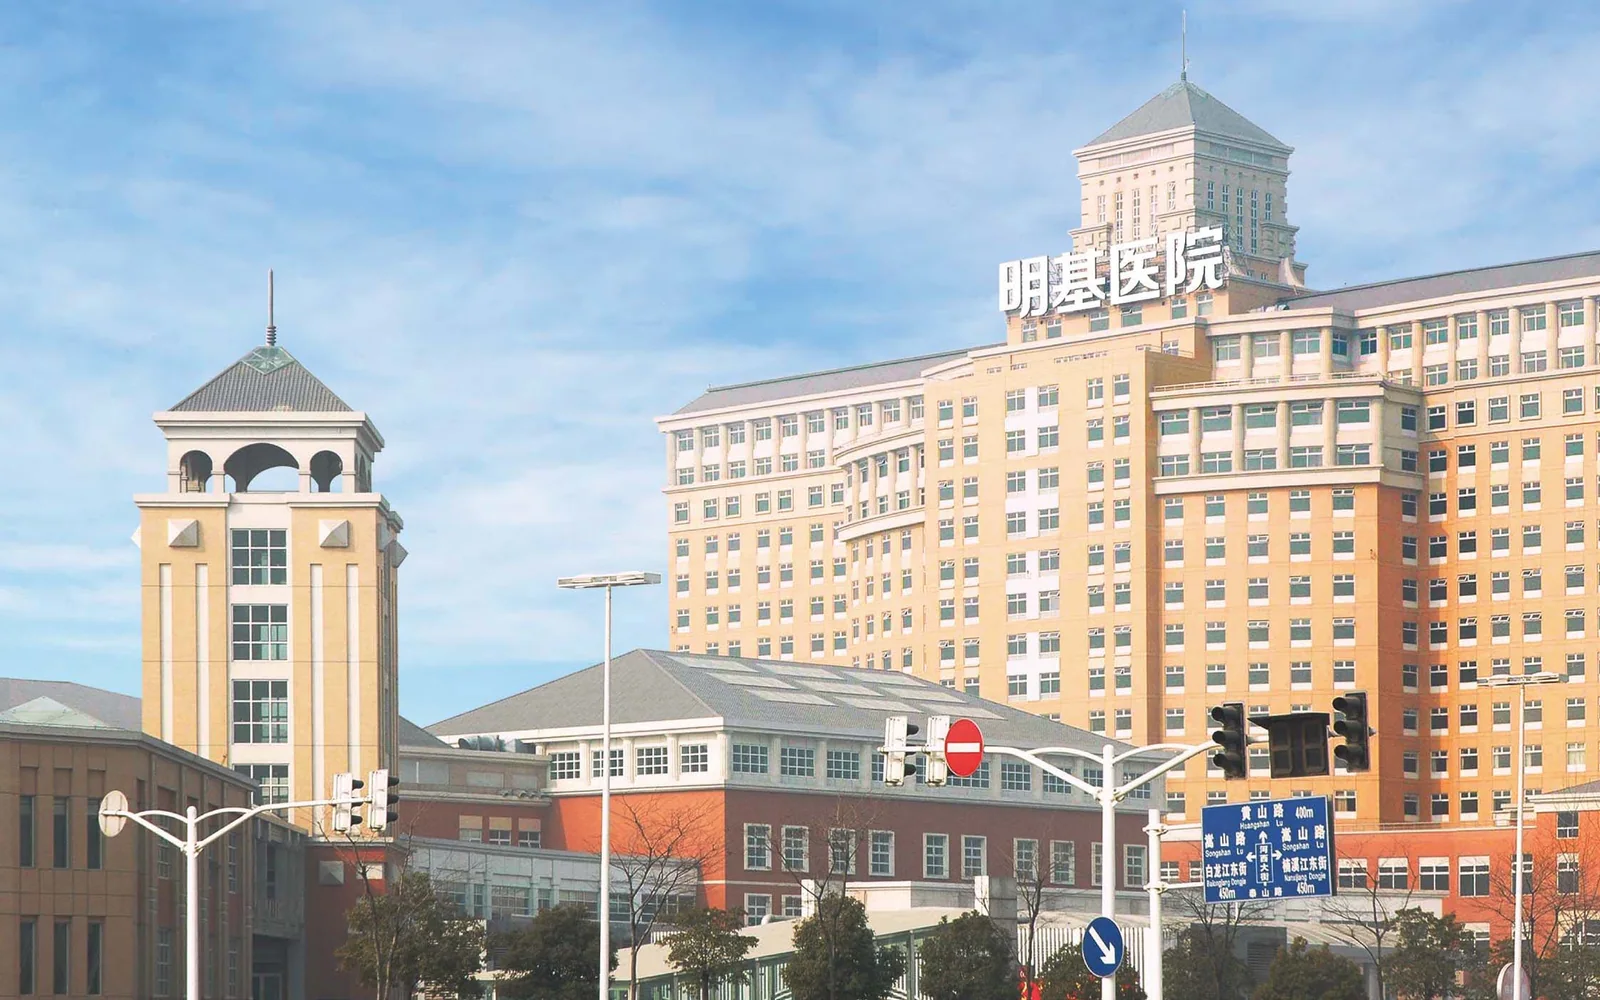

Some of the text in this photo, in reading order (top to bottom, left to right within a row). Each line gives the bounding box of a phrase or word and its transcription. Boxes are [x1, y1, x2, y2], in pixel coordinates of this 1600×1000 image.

[999, 225, 1223, 319] 明基医院
[1241, 803, 1314, 821] 黄山路 400m
[1240, 819, 1284, 830] Huangshan Lu
[1204, 831, 1246, 849] 嵩山路
[1281, 824, 1325, 843] 嵩山路
[1205, 849, 1231, 859] Songshan
[1282, 841, 1324, 852] Songshan Lu
[1205, 861, 1247, 878] 白龙江东街
[1259, 845, 1269, 881] 河西大街
[1282, 855, 1327, 873] 楠溪江东街
[1219, 887, 1236, 900] 450m
[1297, 881, 1315, 895] 450m
